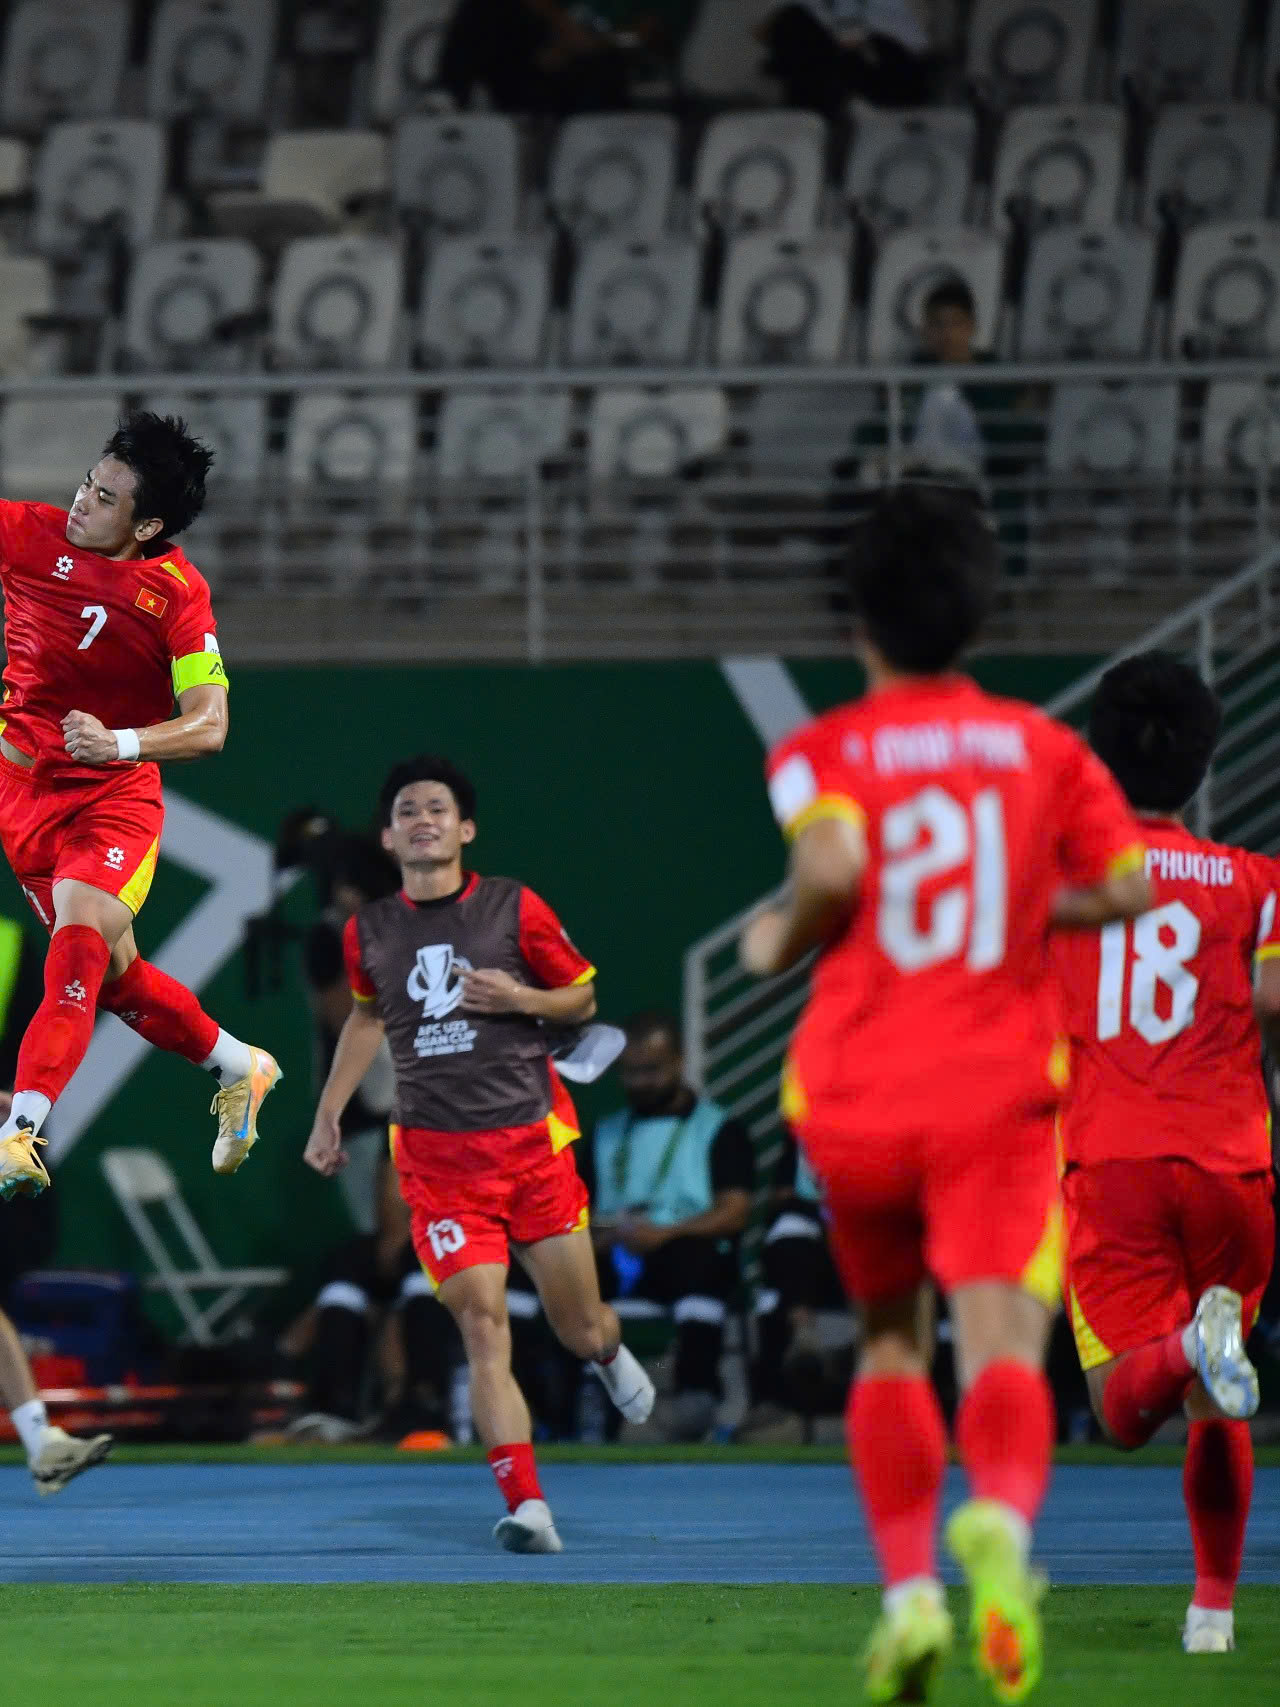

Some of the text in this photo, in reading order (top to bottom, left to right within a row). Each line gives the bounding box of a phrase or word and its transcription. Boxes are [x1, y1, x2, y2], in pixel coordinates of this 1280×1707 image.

[77, 606, 108, 650] 7
[879, 786, 1007, 973] 21
[1097, 901, 1202, 1045] 18
